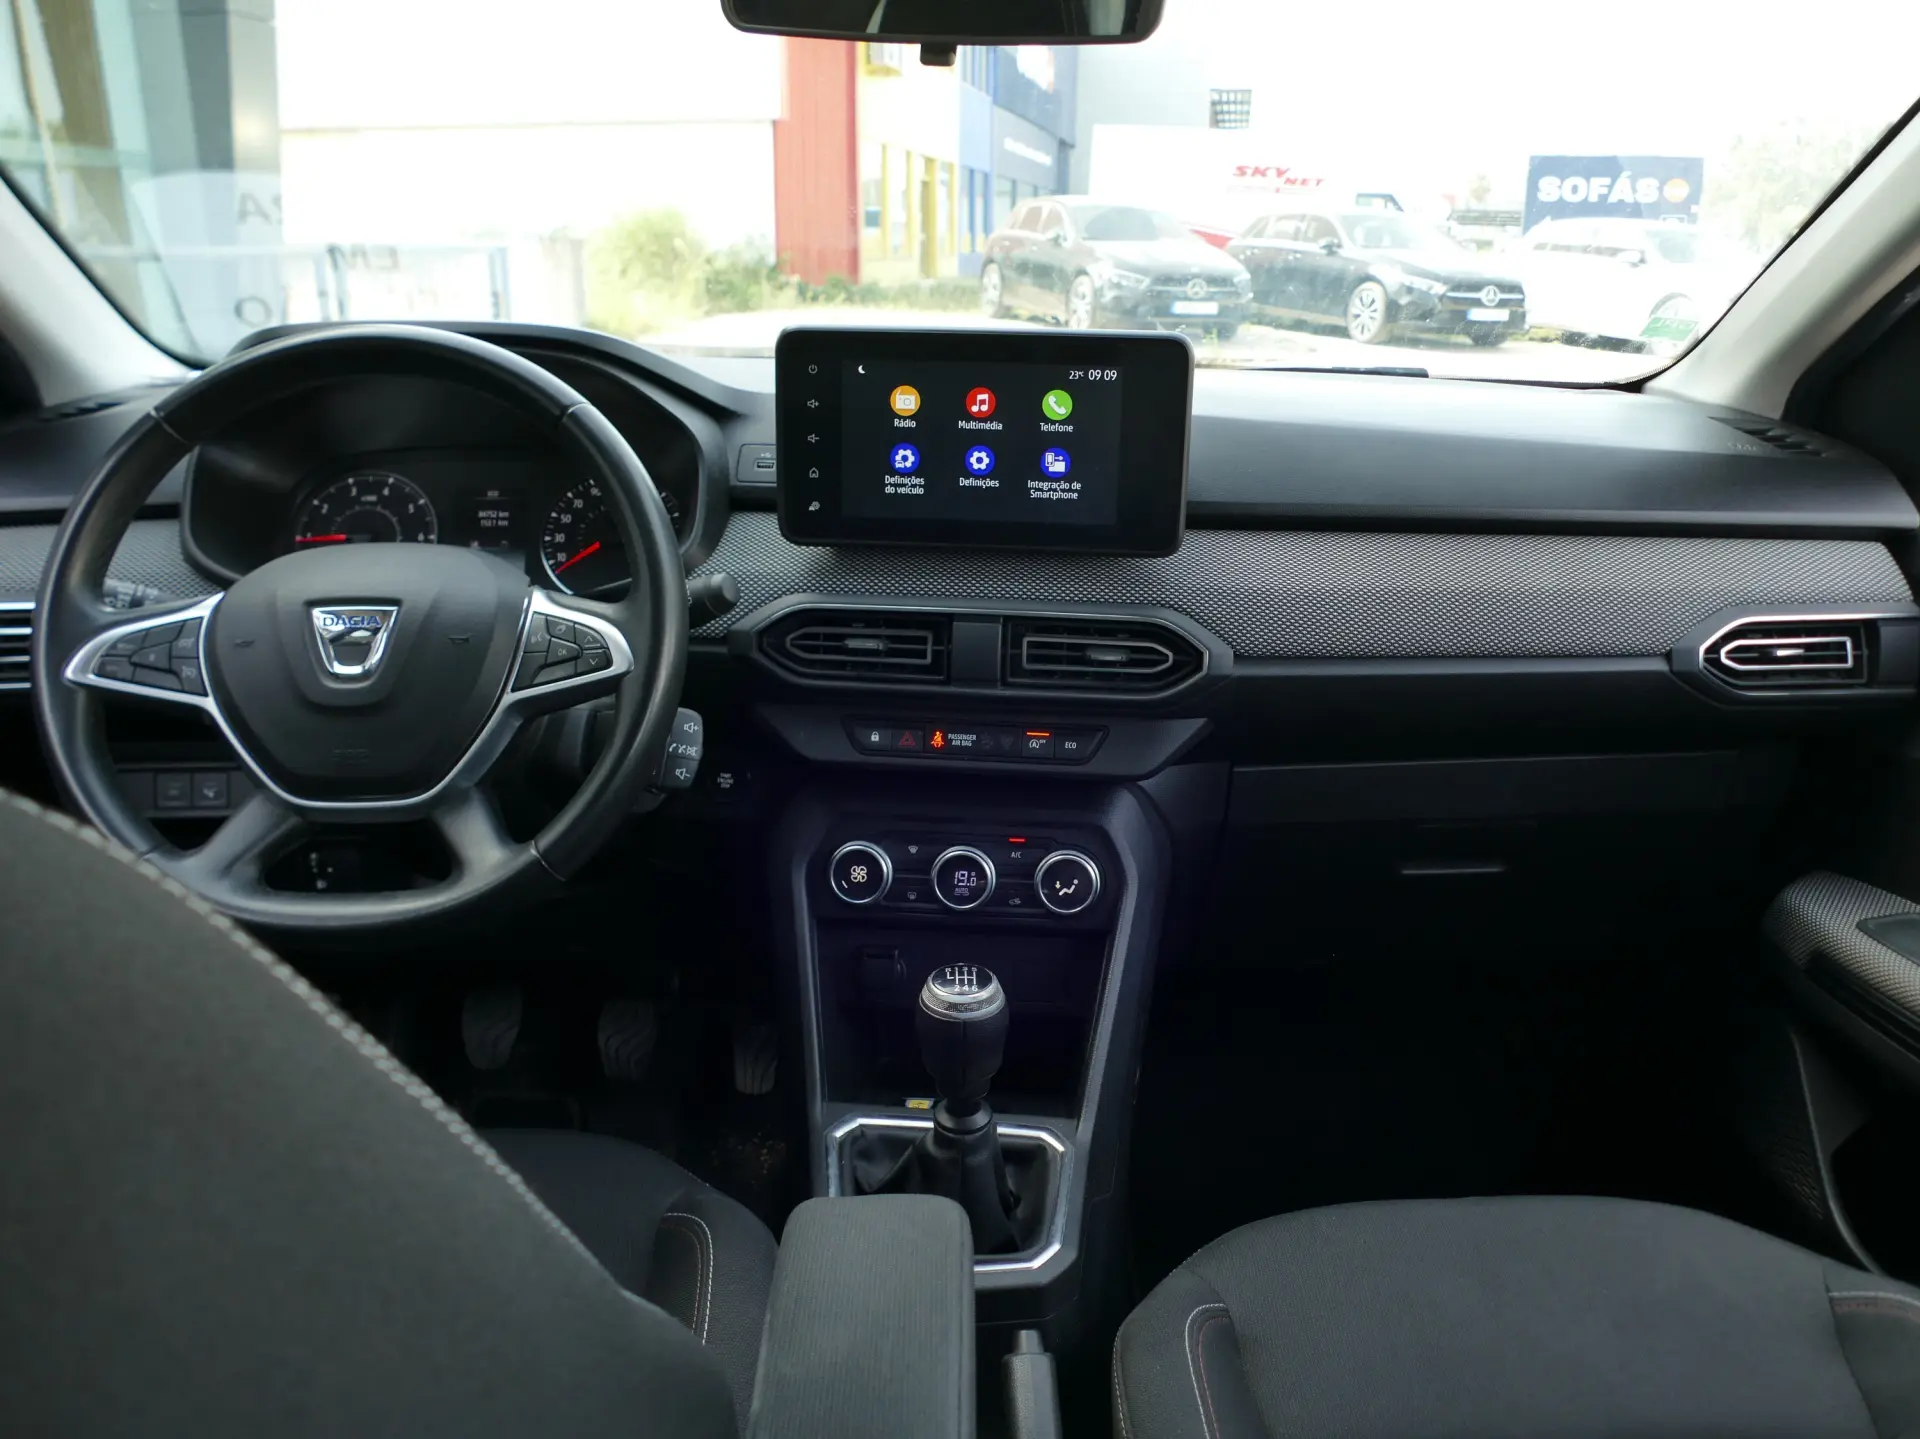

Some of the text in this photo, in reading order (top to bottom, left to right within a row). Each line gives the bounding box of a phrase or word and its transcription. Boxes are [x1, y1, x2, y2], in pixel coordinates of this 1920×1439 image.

[1232, 165, 1291, 179] SKY
[1284, 177, 1325, 187] NET
[1537, 171, 1660, 204] SOFÁS
[1088, 369, 1102, 381] 09
[1103, 369, 1118, 381] 09
[893, 417, 916, 428] Rádio
[957, 420, 1003, 431] Multimédia
[1039, 422, 1074, 433] Telefone
[884, 475, 925, 487] Definições
[958, 476, 1000, 488] Definições
[1027, 479, 1082, 491] Integração de
[382, 486, 390, 496] 4
[884, 484, 924, 495] do veículo
[1029, 489, 1079, 500] Smartphone
[572, 499, 584, 509] 70
[560, 514, 572, 524] 50
[417, 532, 425, 542] 6
[554, 533, 566, 543] 30
[557, 552, 567, 562] 10
[322, 615, 381, 627] DACIA
[557, 648, 568, 656] OK
[948, 733, 977, 741] PASSENGER
[1064, 741, 1077, 749] ECO
